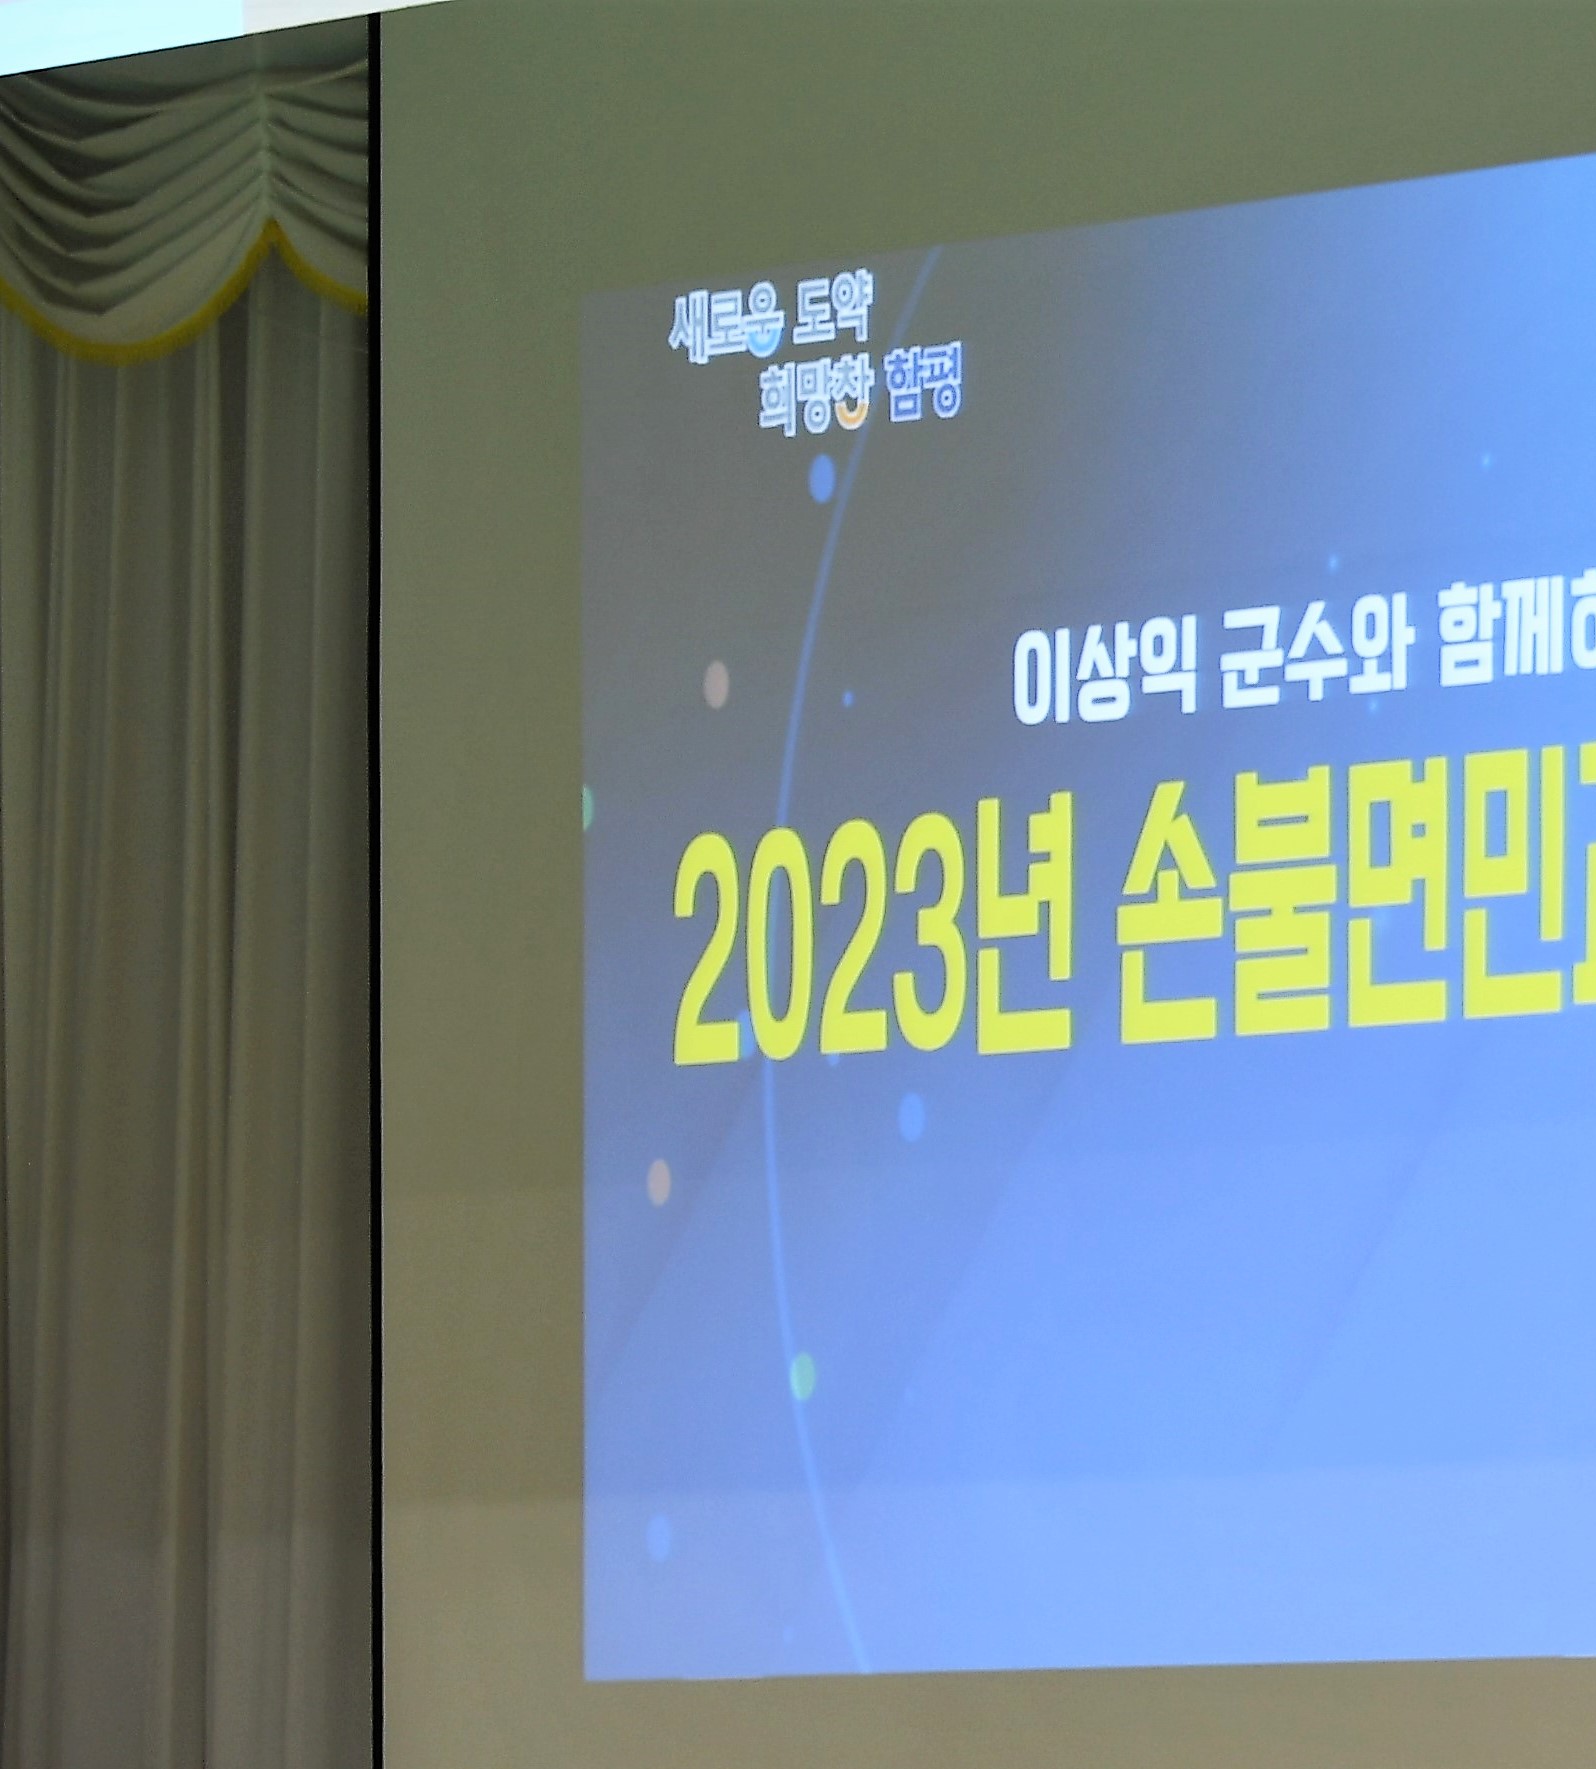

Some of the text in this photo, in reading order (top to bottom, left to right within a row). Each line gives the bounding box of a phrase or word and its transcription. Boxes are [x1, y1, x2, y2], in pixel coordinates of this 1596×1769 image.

[668, 267, 874, 365] 새로운 도약
[758, 340, 962, 437] 희망찬 함평
[1013, 614, 1199, 726] 이상익
[1219, 590, 1415, 710] 군수와
[672, 790, 1075, 1067] 2023년
